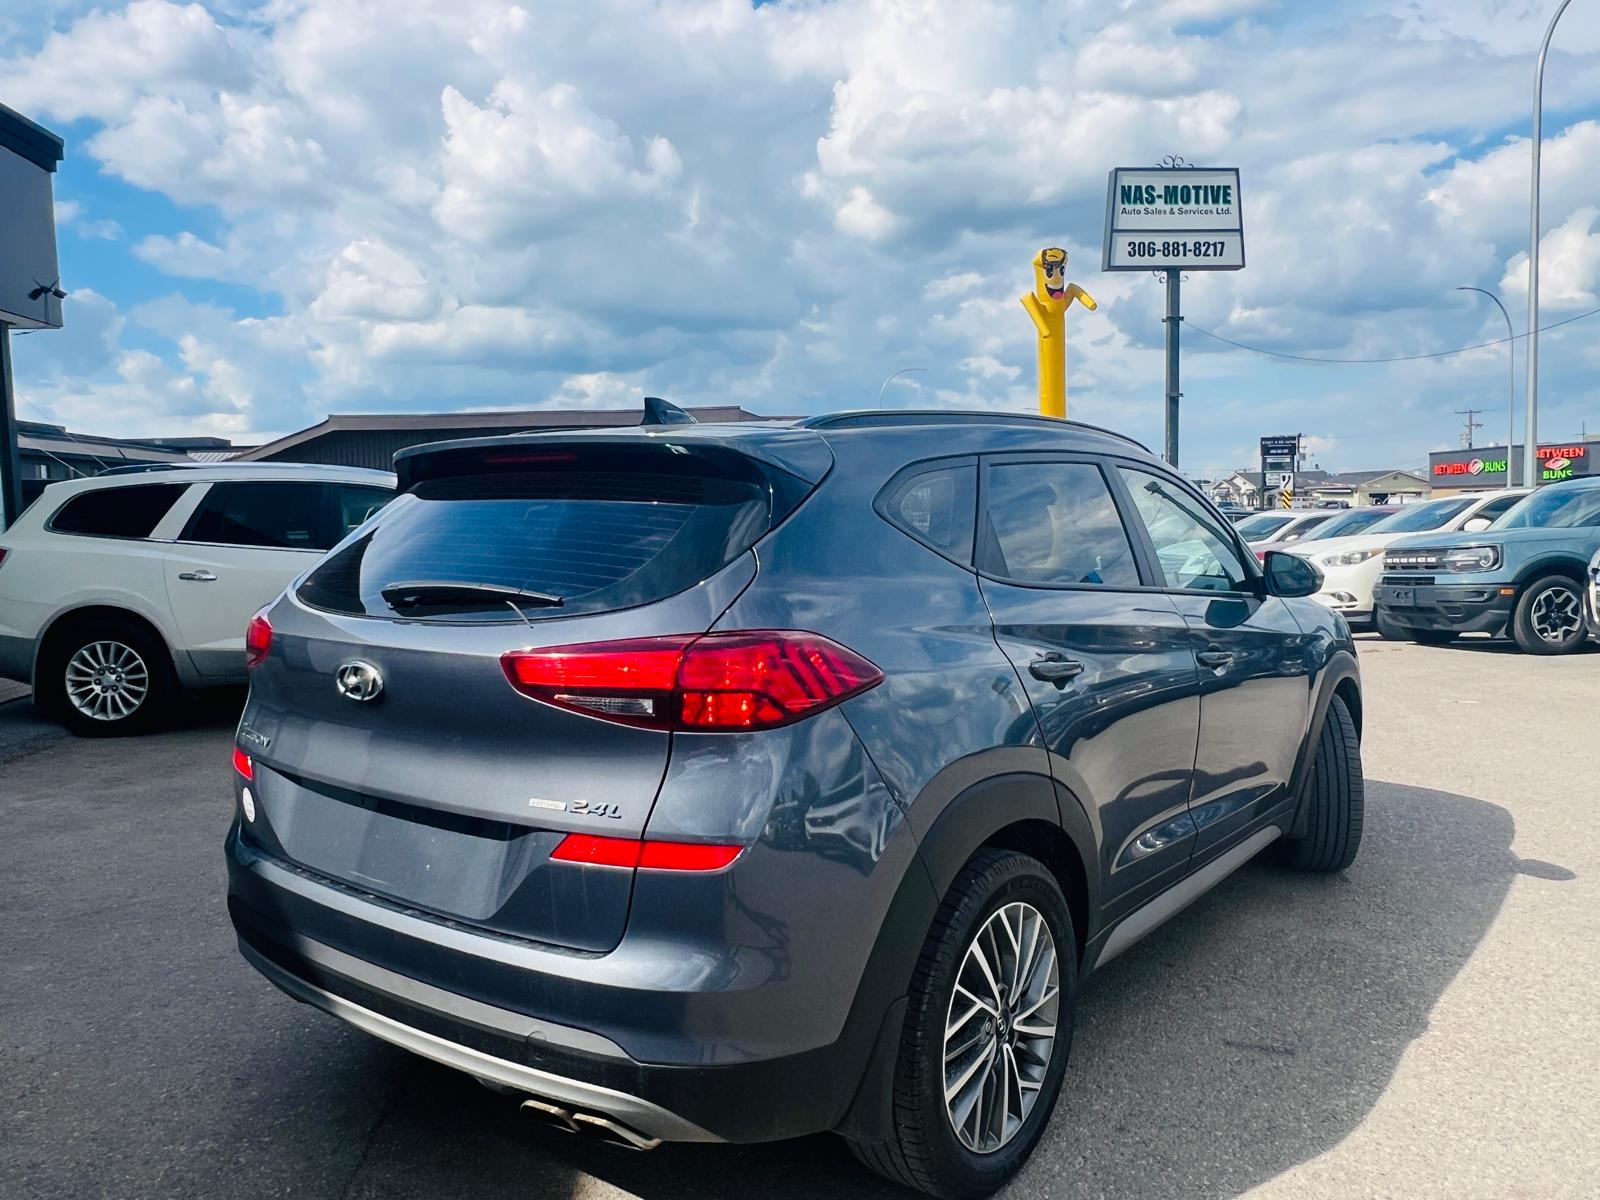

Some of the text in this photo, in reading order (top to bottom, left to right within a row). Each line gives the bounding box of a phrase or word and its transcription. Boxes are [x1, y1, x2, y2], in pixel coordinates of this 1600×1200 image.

[1120, 185, 1232, 205] NAS-MOTIVE
[1120, 207, 1232, 215] Auto Sales & Services Ltd.
[1127, 241, 1226, 258] 306-881-8217
[1484, 461, 1507, 472] BUNS
